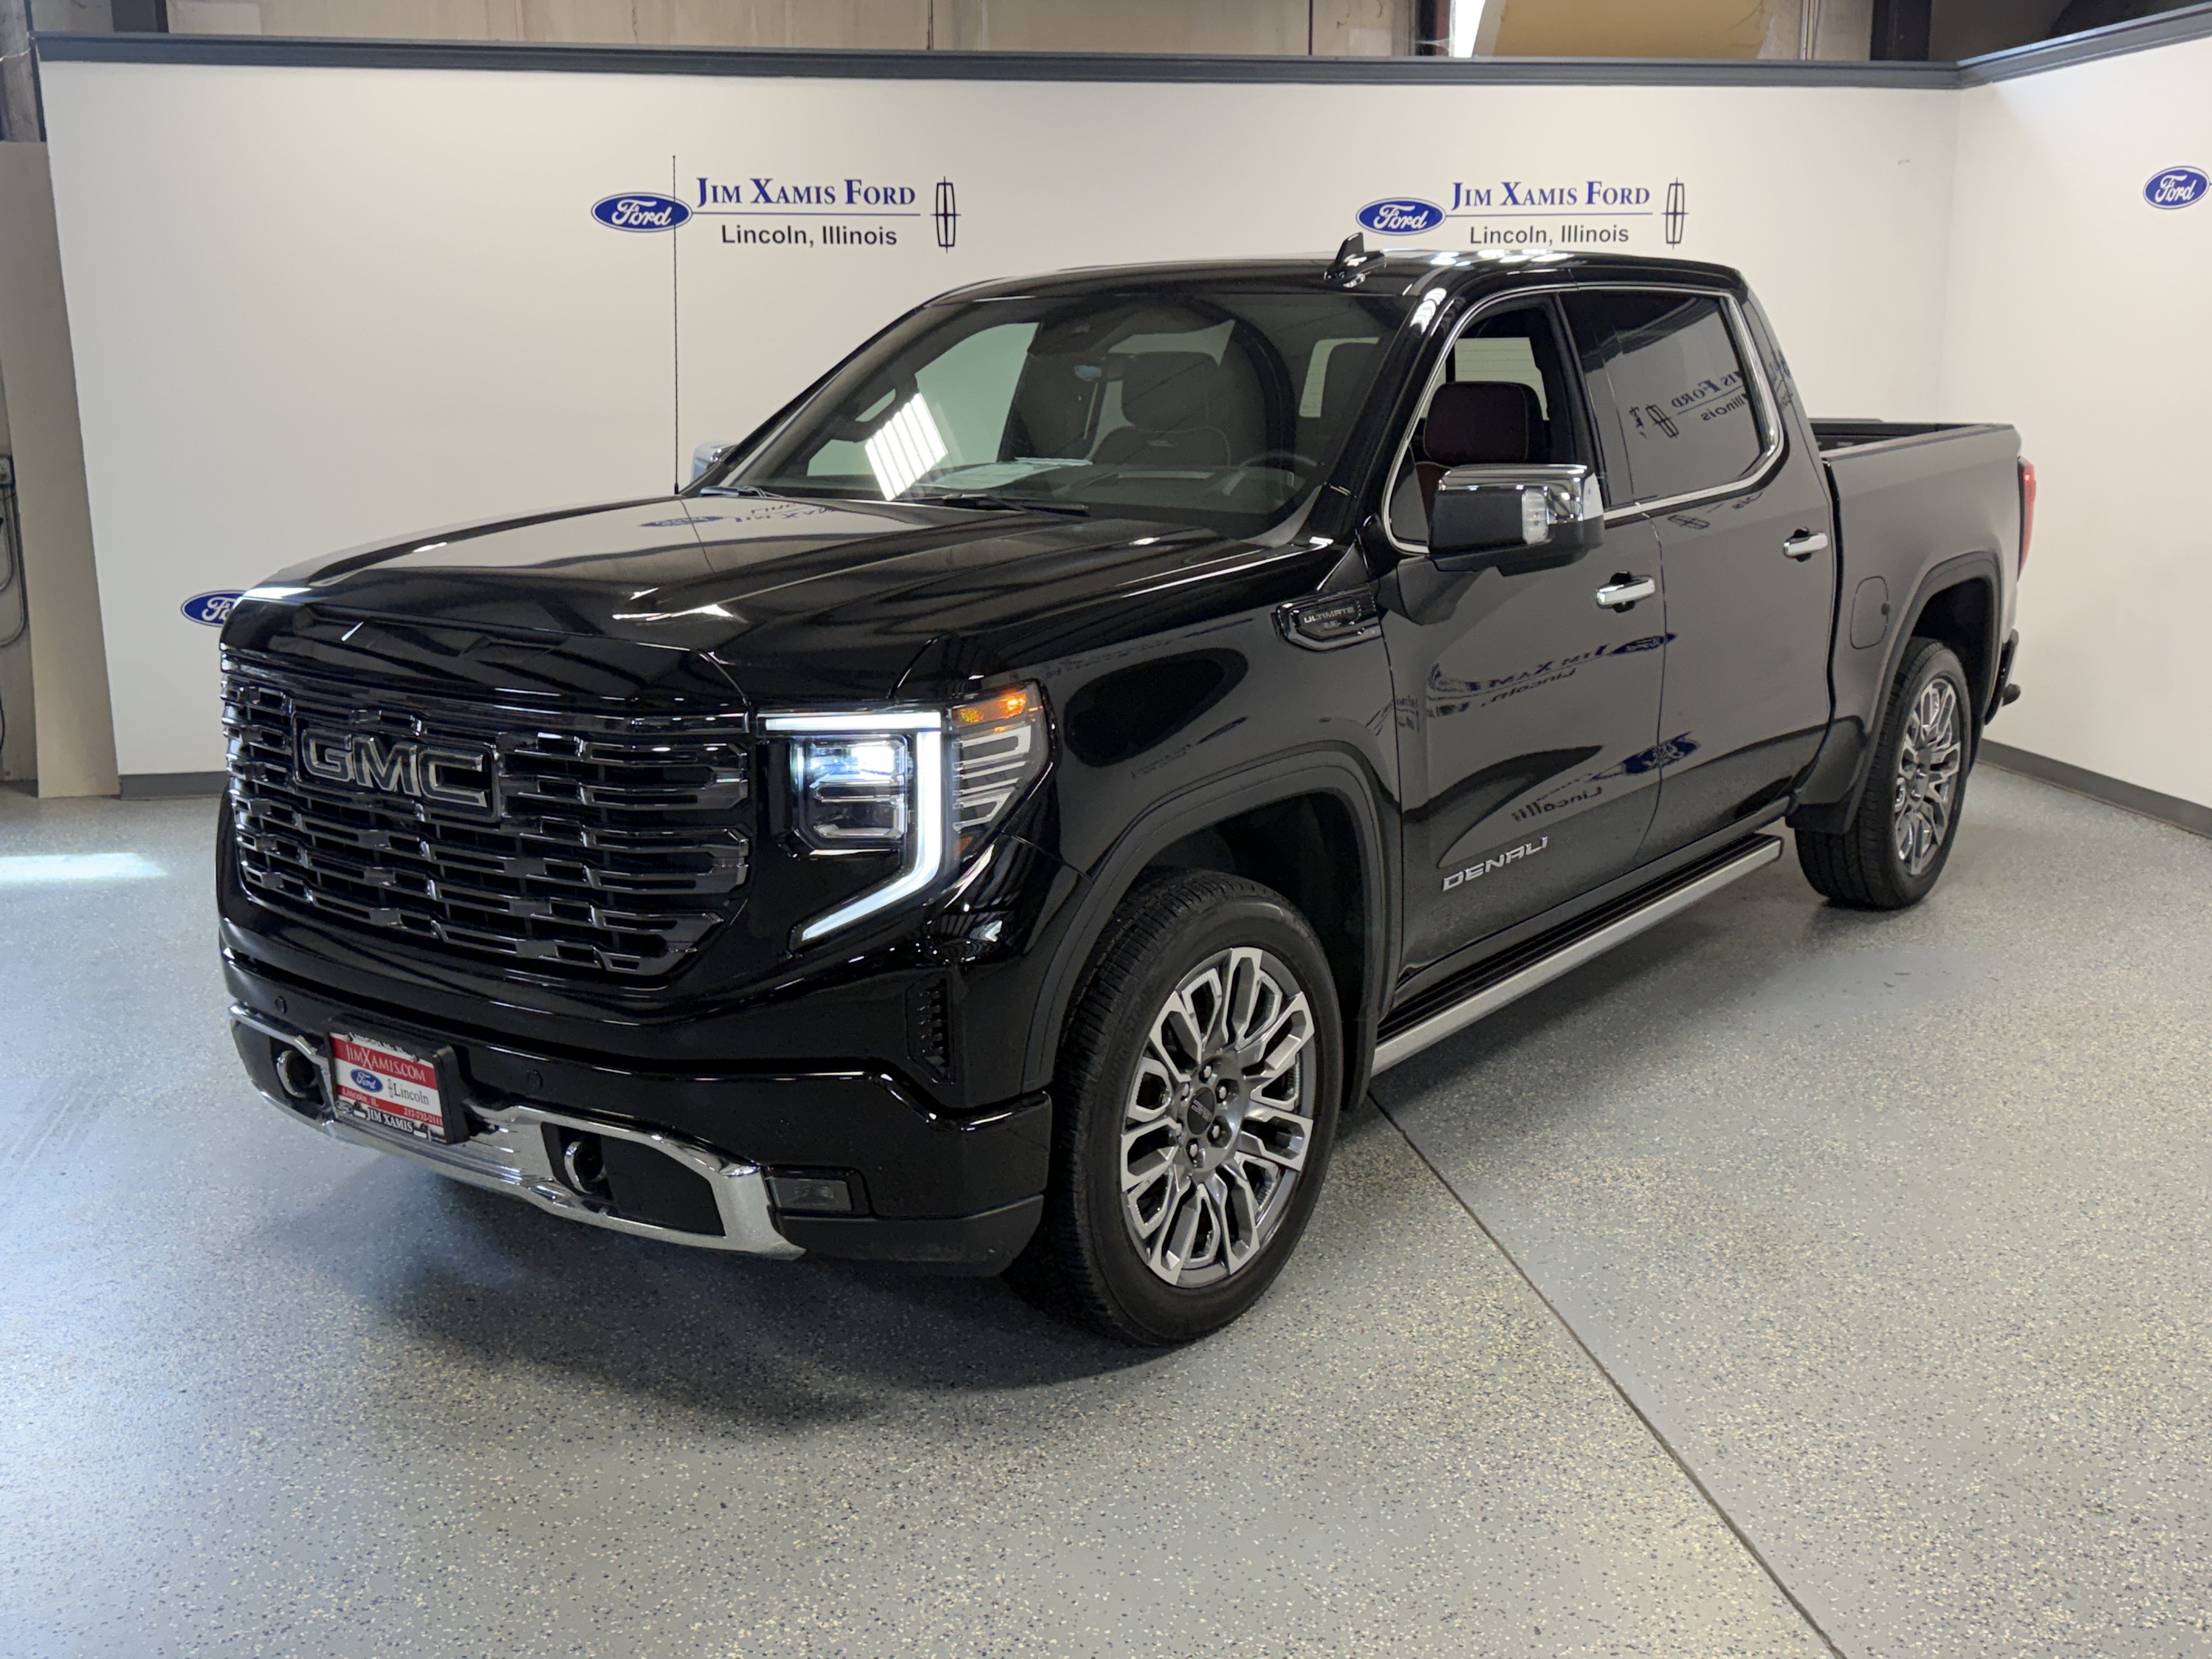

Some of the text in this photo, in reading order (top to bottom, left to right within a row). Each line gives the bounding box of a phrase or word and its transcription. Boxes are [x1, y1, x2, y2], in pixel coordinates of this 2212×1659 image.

[2154, 174, 2197, 203] Ford
[611, 199, 673, 226] Ford
[1373, 204, 1429, 229] Ford
[721, 224, 898, 248] Lincoln, Illinois
[1470, 224, 1629, 246] Lincoln, Illinois
[1304, 606, 1354, 623] ULTIMATE
[301, 728, 488, 808] GMC
[1442, 836, 1548, 891] DENALI
[357, 1071, 376, 1090] Ford
[393, 1083, 430, 1105] Lincoln
[366, 1108, 413, 1133] JIM XAMIS
